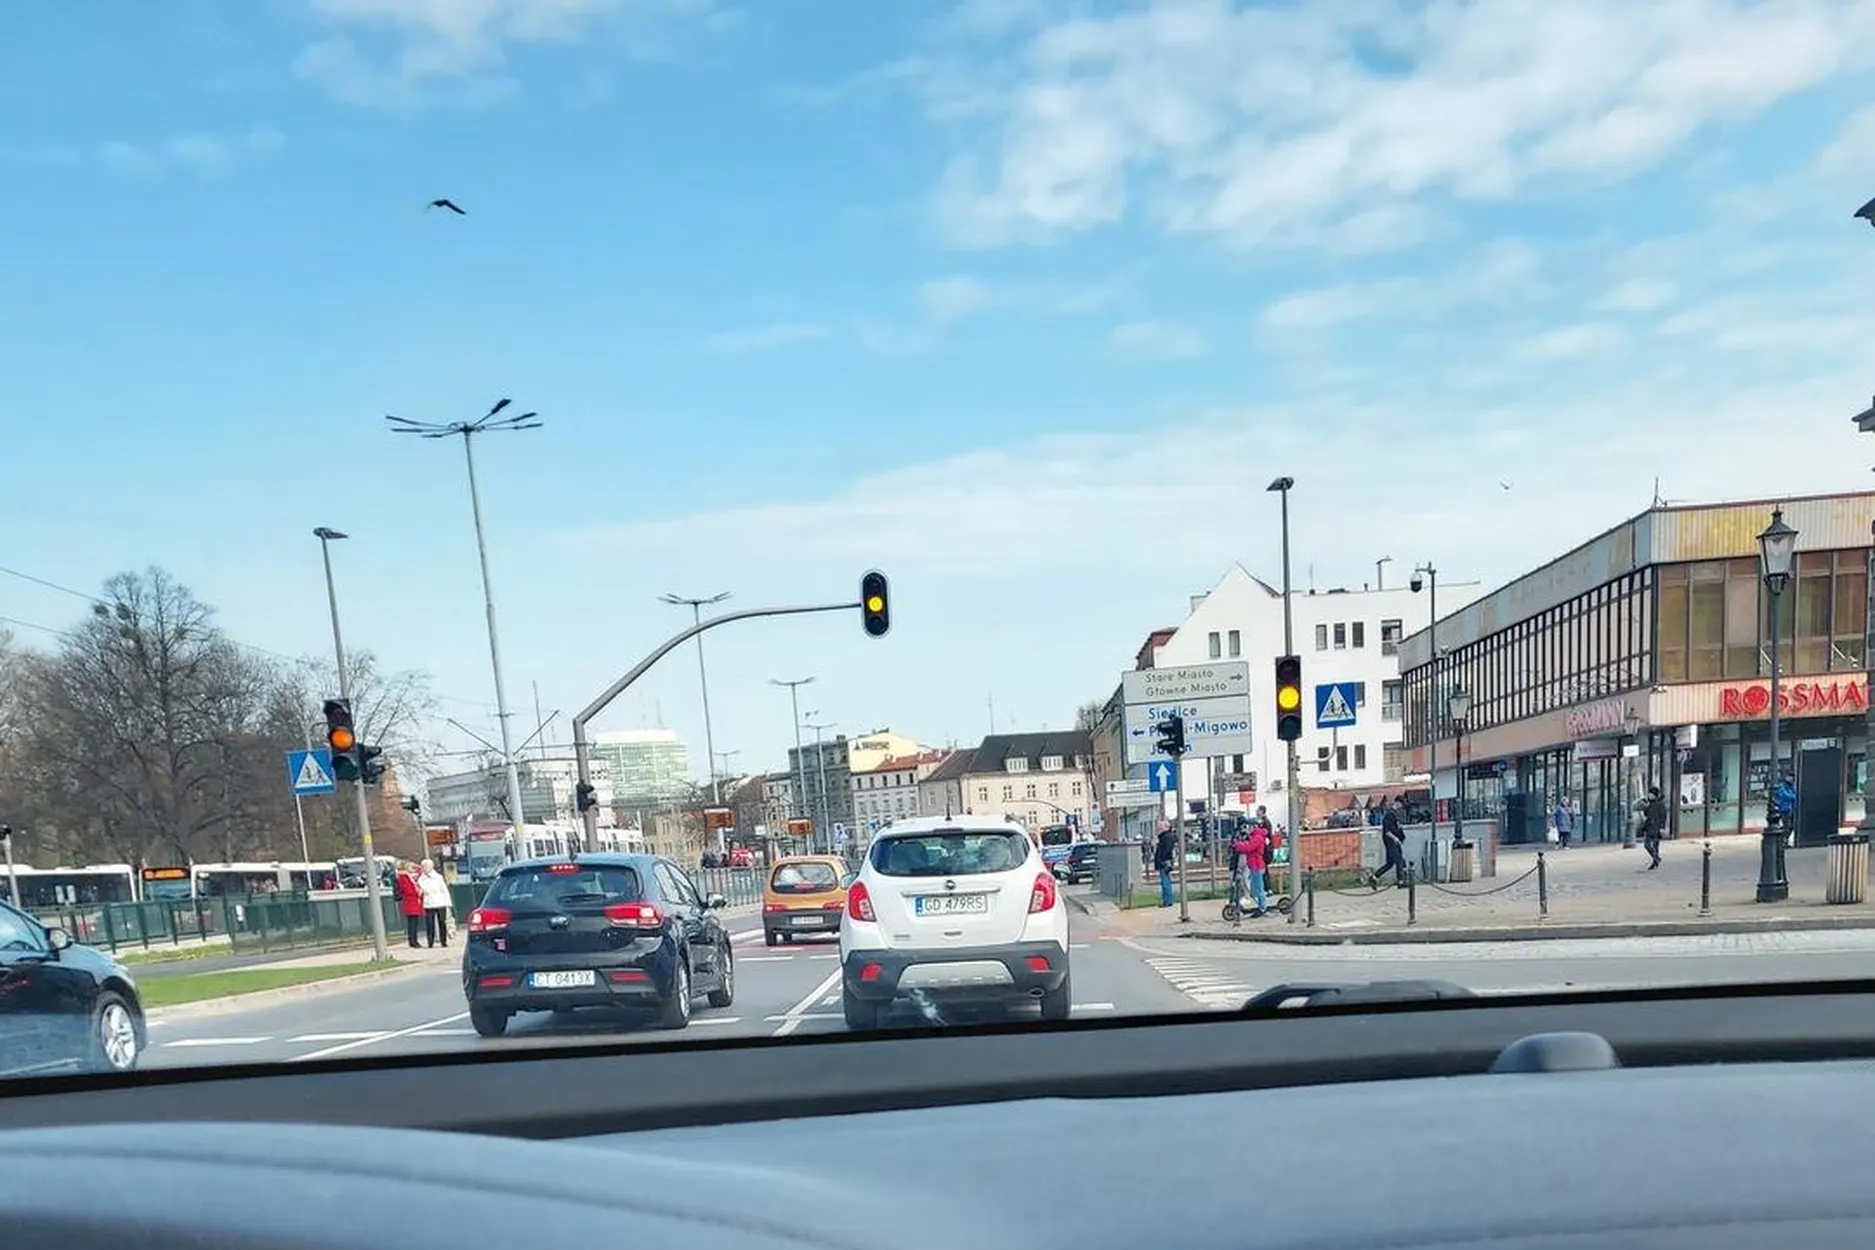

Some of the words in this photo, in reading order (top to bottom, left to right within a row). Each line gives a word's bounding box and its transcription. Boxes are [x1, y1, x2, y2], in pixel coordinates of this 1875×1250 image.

[1177, 669, 1214, 680] Miasto
[1190, 682, 1228, 693] Miasto
[1721, 681, 1868, 714] ROSSMA
[1148, 706, 1198, 720] Siedlce
